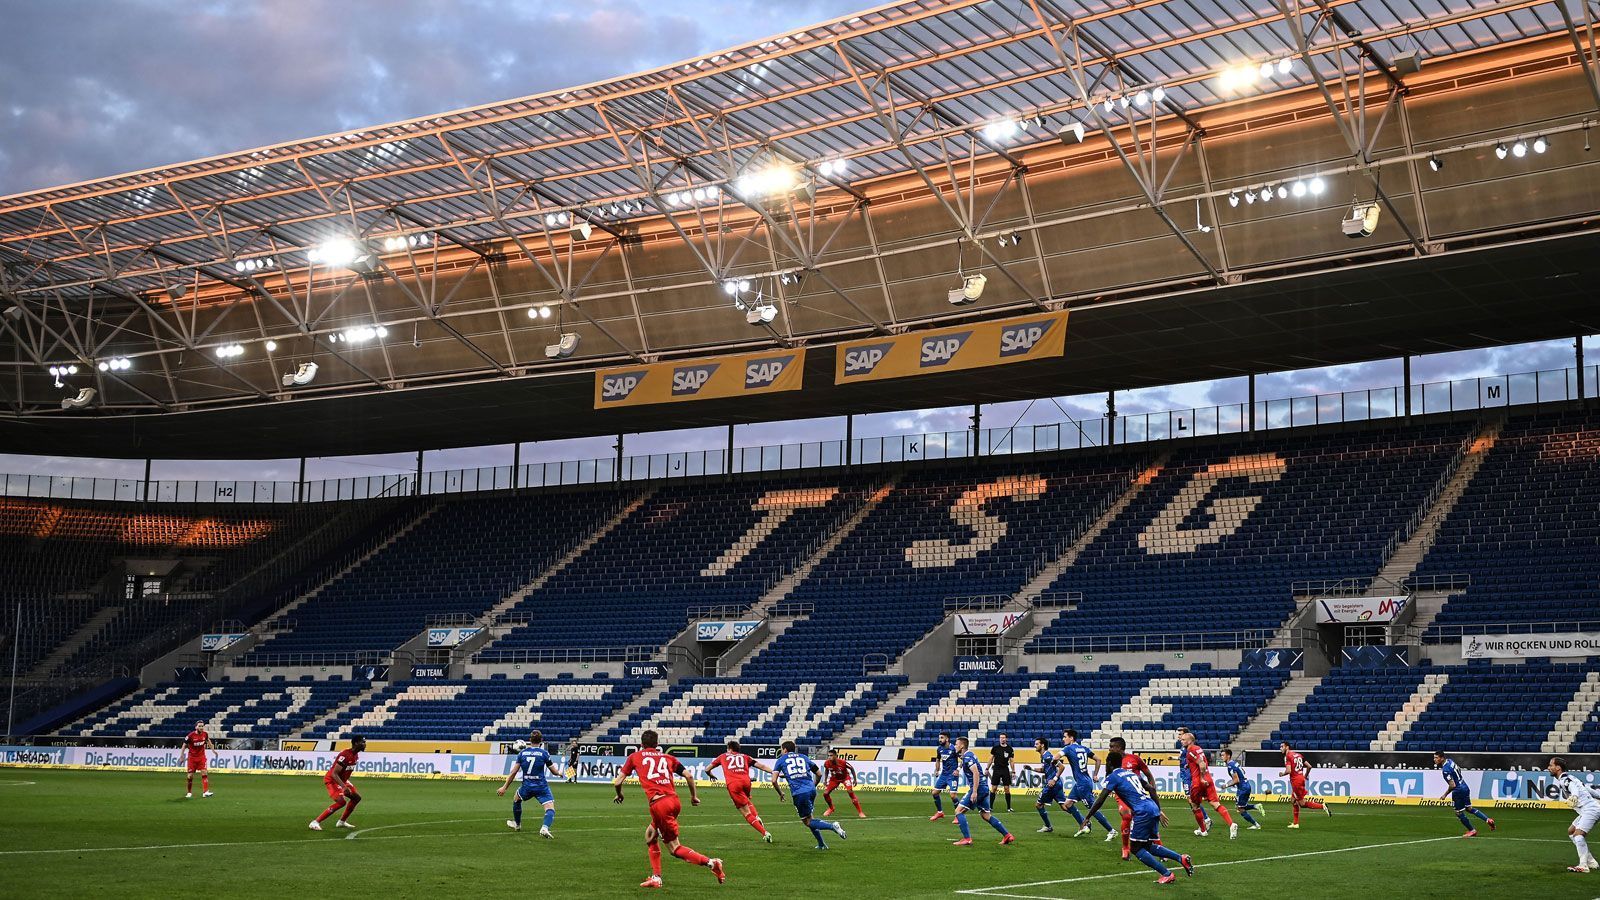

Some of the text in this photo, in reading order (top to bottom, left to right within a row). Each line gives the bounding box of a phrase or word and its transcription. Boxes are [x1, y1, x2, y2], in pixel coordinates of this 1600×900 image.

[1002, 326, 1042, 352] SAP
[921, 338, 960, 362] SAP
[846, 348, 884, 372] SAP
[746, 362, 783, 384] SAP
[672, 369, 708, 392] SAP
[602, 376, 638, 398] SAP
[1488, 387, 1500, 398] M
[1178, 419, 1186, 430] L
[910, 442, 918, 453] K
[674, 461, 680, 470] J
[218, 487, 233, 497] H2
[700, 453, 1288, 577] TSG
[430, 632, 446, 642] SAP
[698, 626, 719, 637] SAP
[203, 636, 218, 648] SAP
[1485, 642, 1504, 650] WIR
[1506, 641, 1547, 650] ROCKEN
[1550, 640, 1572, 649] UND
[631, 666, 659, 675] EIN WEG.
[959, 661, 997, 670] EINMALIG.
[416, 669, 443, 677] EIN TEAM.
[579, 745, 598, 754] pre
[758, 748, 776, 758] pre
[86, 752, 103, 766] Die
[210, 756, 229, 769] der
[526, 757, 536, 774] 7
[726, 755, 744, 770] 20
[785, 757, 807, 775] 29
[1294, 757, 1304, 772] 28
[642, 757, 670, 780] 24
[1347, 796, 1395, 805] interwetten
[1494, 800, 1546, 809] interwetten
